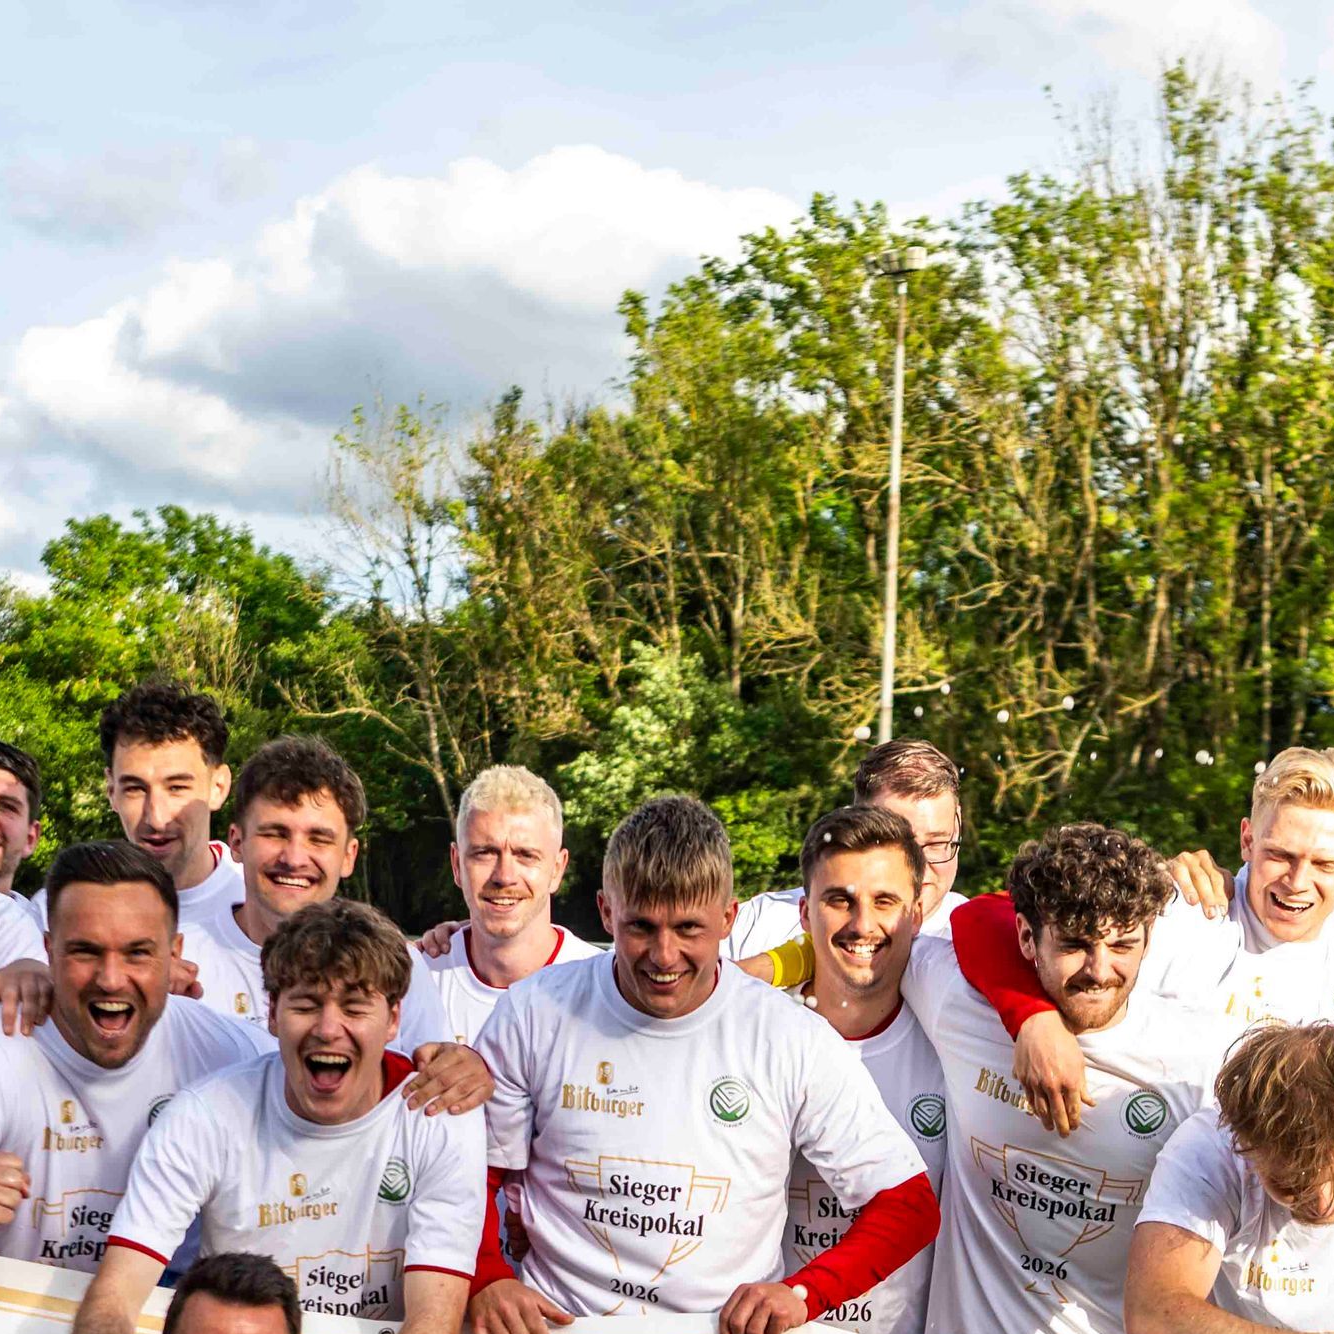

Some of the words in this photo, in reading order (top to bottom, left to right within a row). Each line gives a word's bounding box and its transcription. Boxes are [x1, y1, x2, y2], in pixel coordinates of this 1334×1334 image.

[560, 1083, 645, 1119] Bitburger
[973, 1066, 1038, 1118] Bitburg
[609, 1173, 682, 1206] Sieger
[1014, 1163, 1091, 1196] Sieger
[991, 1178, 1117, 1223] Kreispokal
[70, 1205, 115, 1233] Sieg
[583, 1198, 704, 1237] Kreispokal
[40, 1235, 108, 1262] Kreisp
[1020, 1254, 1068, 1281] 2026
[610, 1278, 660, 1304] 2026
